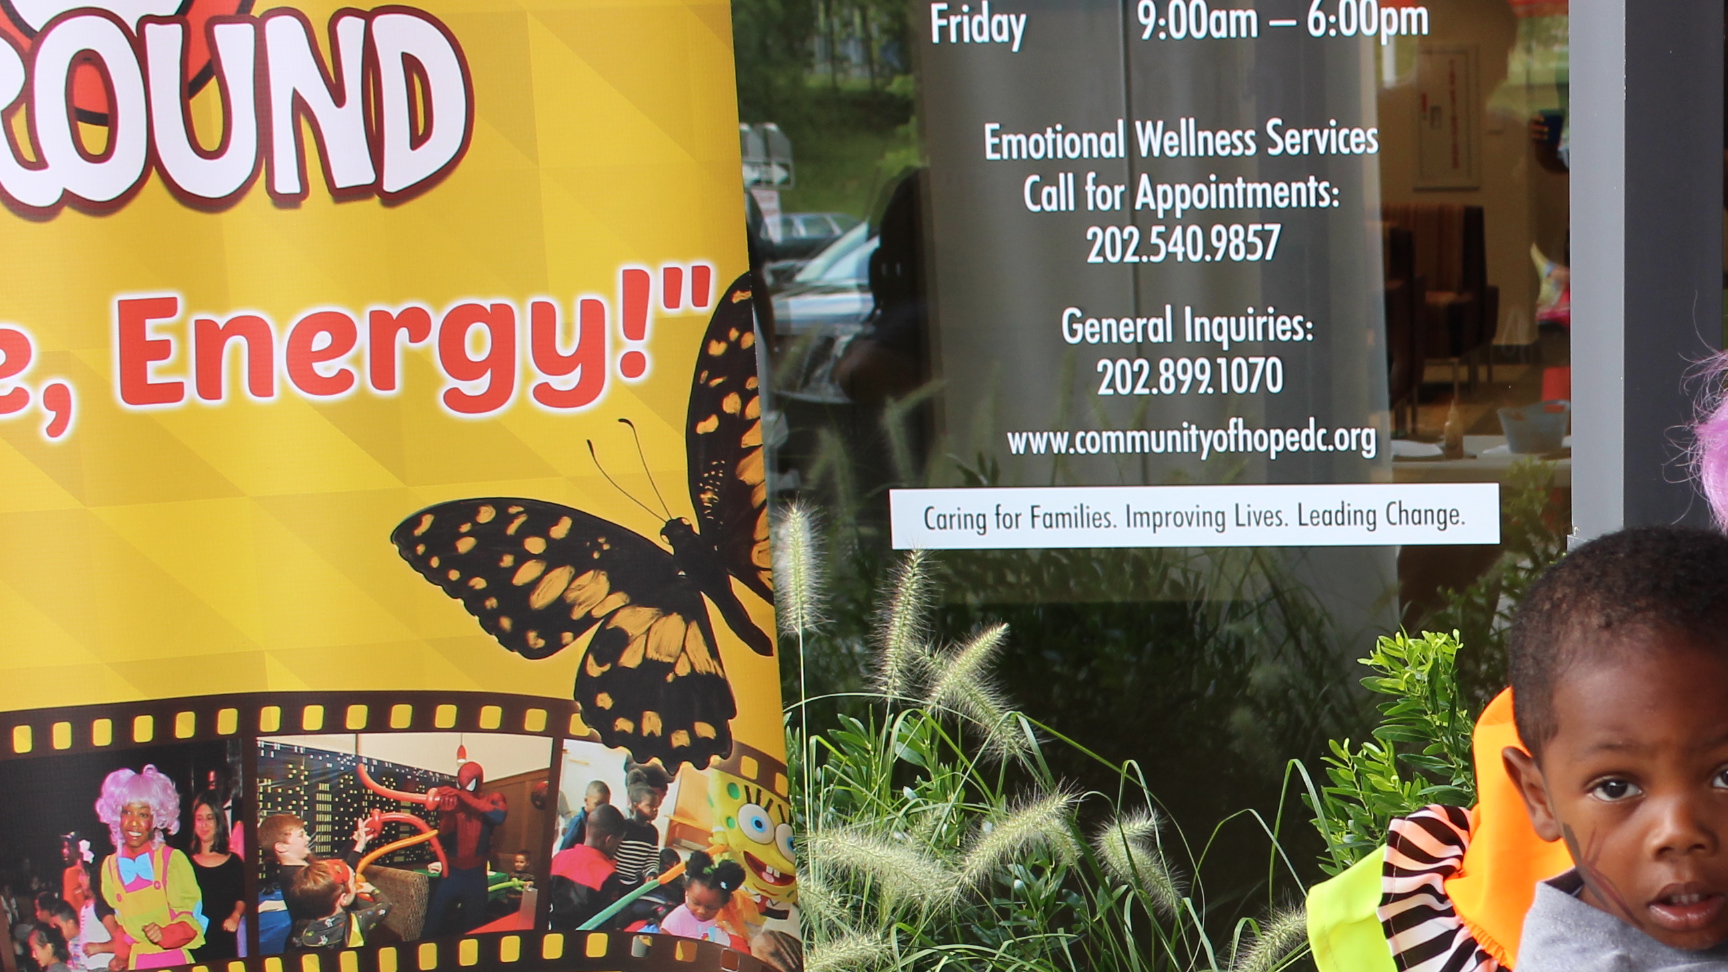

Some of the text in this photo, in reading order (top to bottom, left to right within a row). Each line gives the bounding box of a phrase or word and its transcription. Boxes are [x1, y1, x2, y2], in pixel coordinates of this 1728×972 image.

[931, 2, 1027, 52] Friday
[1137, 0, 1258, 40] 9:00am
[1307, 0, 1430, 45] 6:00pm
[984, 117, 1379, 160] Emotional Wellness Services
[1024, 171, 1340, 219] Call for Appointments:
[1086, 223, 1281, 263] 202.540.9857
[116, 264, 713, 415] Energy!"
[1062, 304, 1314, 350] General Inquiries:
[1096, 356, 1283, 396] 202.899.1070
[1007, 417, 1377, 460] www.communityofhopedc.org
[923, 500, 1466, 536] Caring for Families. Improving Lives. Leading Change.
